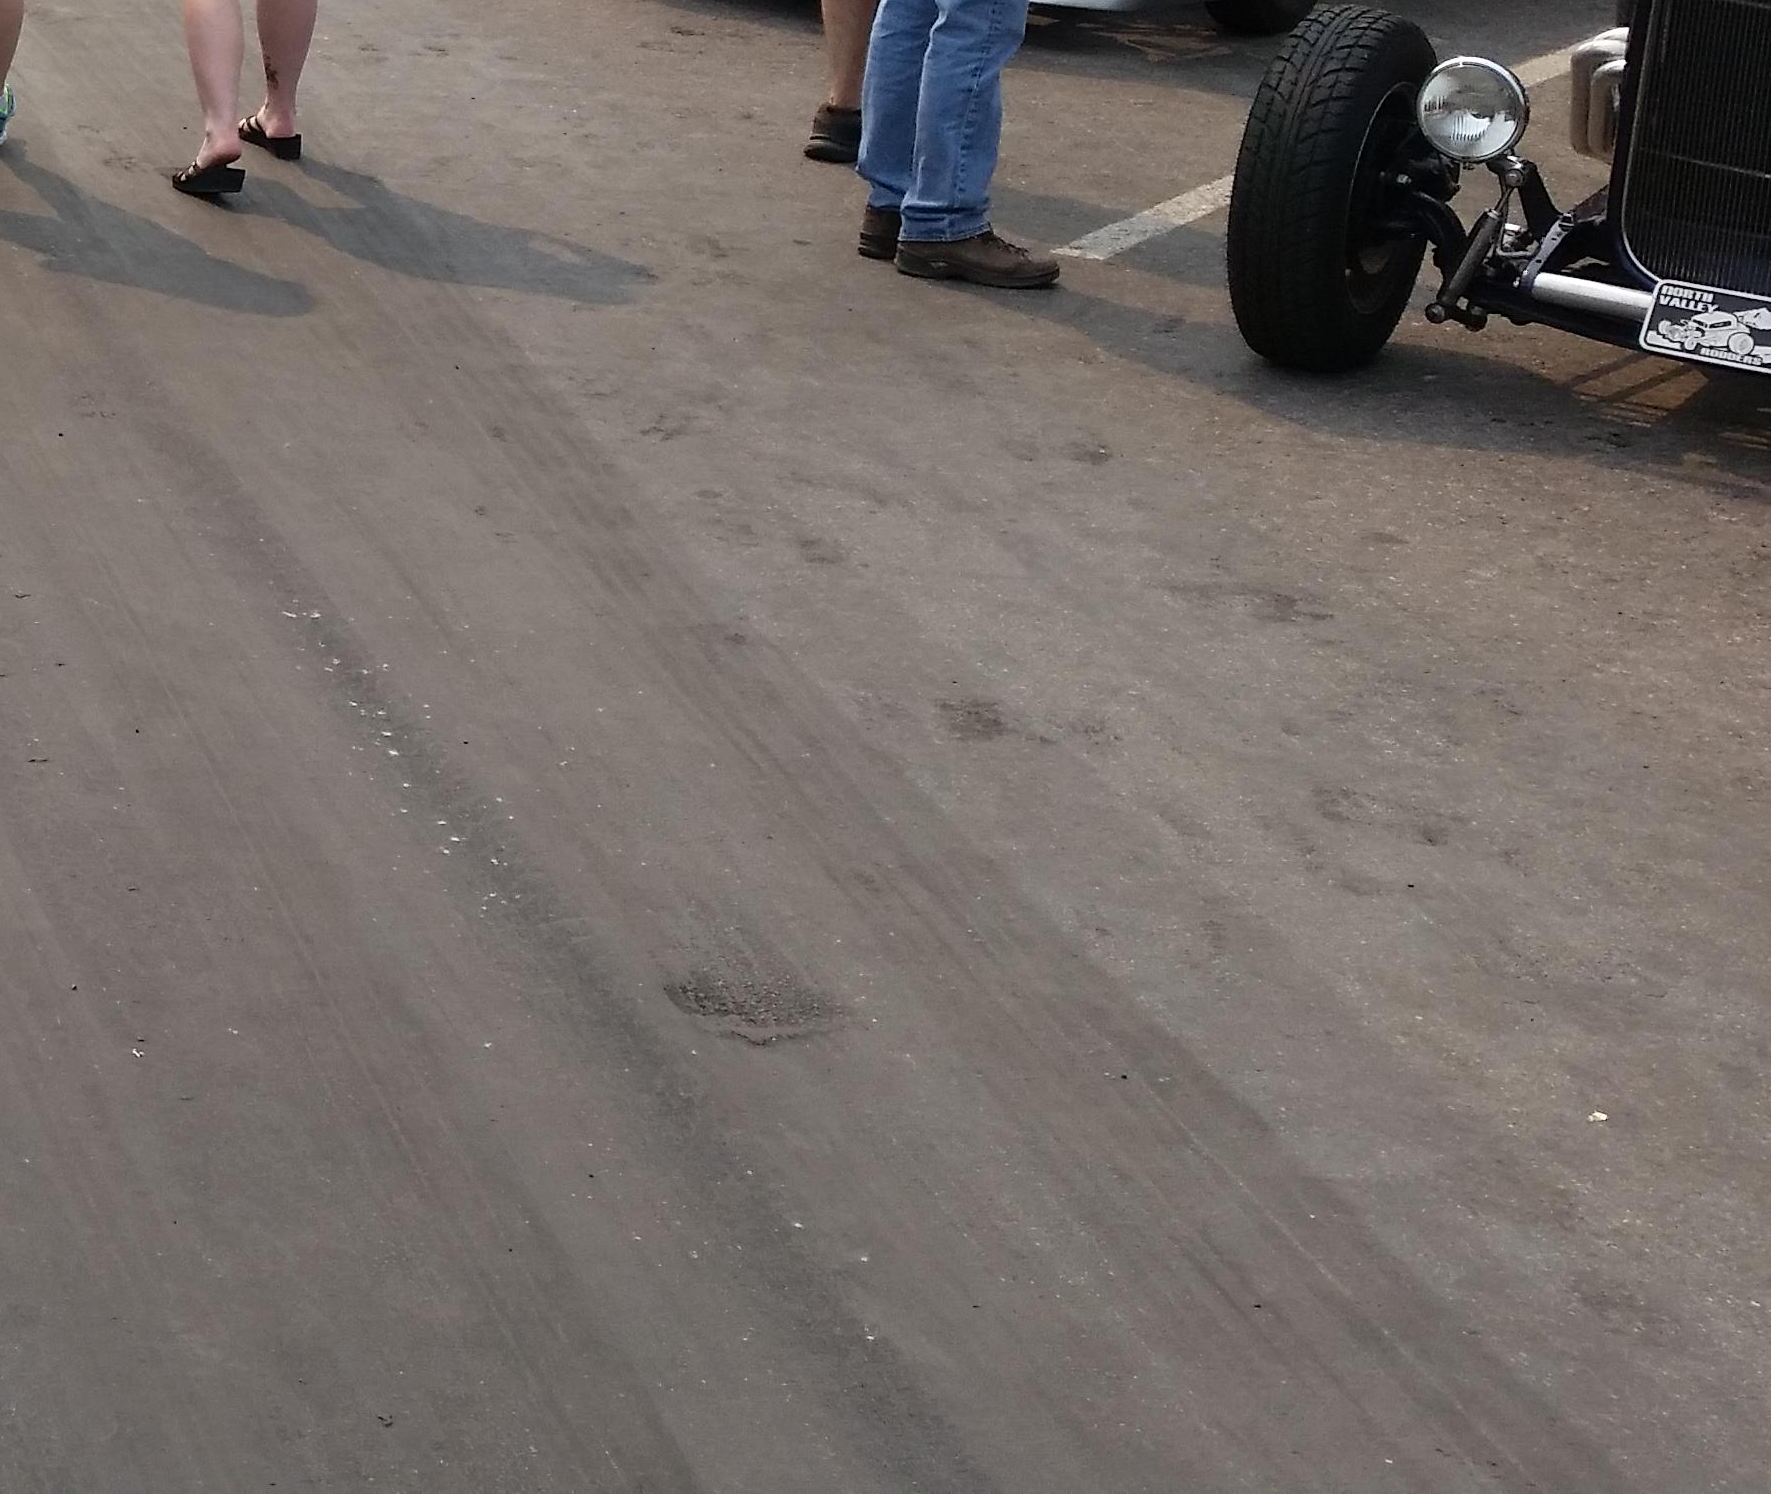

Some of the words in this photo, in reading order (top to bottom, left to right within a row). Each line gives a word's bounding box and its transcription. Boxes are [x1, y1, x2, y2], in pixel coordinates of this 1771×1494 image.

[1661, 285, 1714, 303] NORTH
[1659, 295, 1719, 313] VALLEY
[1700, 347, 1763, 366] RODDERS
